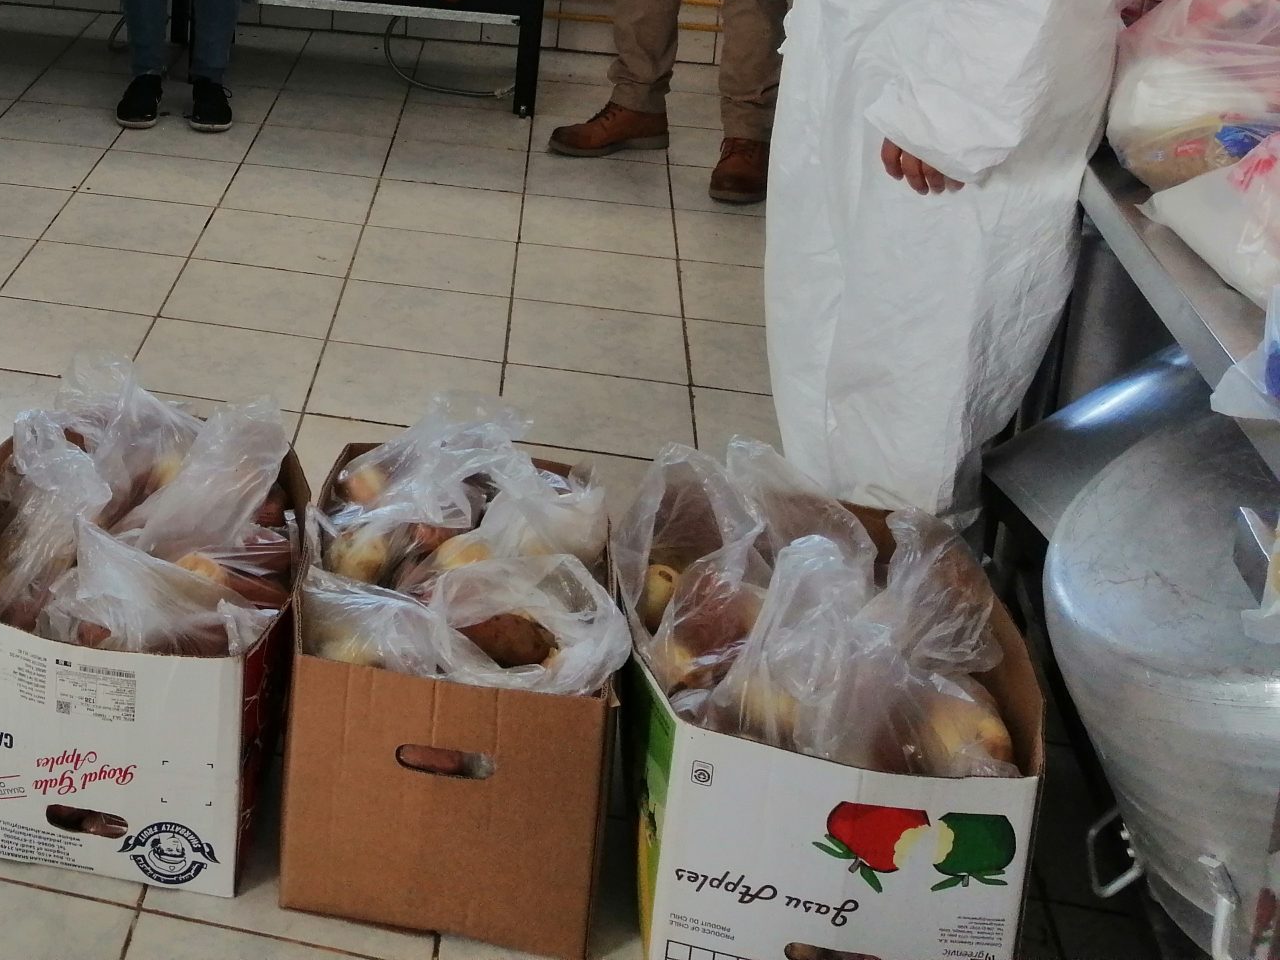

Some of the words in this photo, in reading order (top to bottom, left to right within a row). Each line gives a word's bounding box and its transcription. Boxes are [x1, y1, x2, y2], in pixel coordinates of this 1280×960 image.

[36, 748, 98, 772] Apples
[33, 770, 77, 795] Gala
[81, 765, 137, 790] Royal
[138, 825, 158, 842] FRUIT
[161, 824, 201, 848] SHARBATLY
[0, 839, 19, 847] Arabia
[44, 848, 70, 856] Kingdom
[675, 869, 778, 905] Apples
[670, 913, 688, 922] CHILI
[785, 895, 860, 927] Jasu
[669, 919, 689, 929] CHILE
[689, 917, 699, 925] DU
[700, 921, 731, 933] PRODUIT
[701, 927, 735, 941] PRODUCE
[942, 948, 984, 959] greenvic
